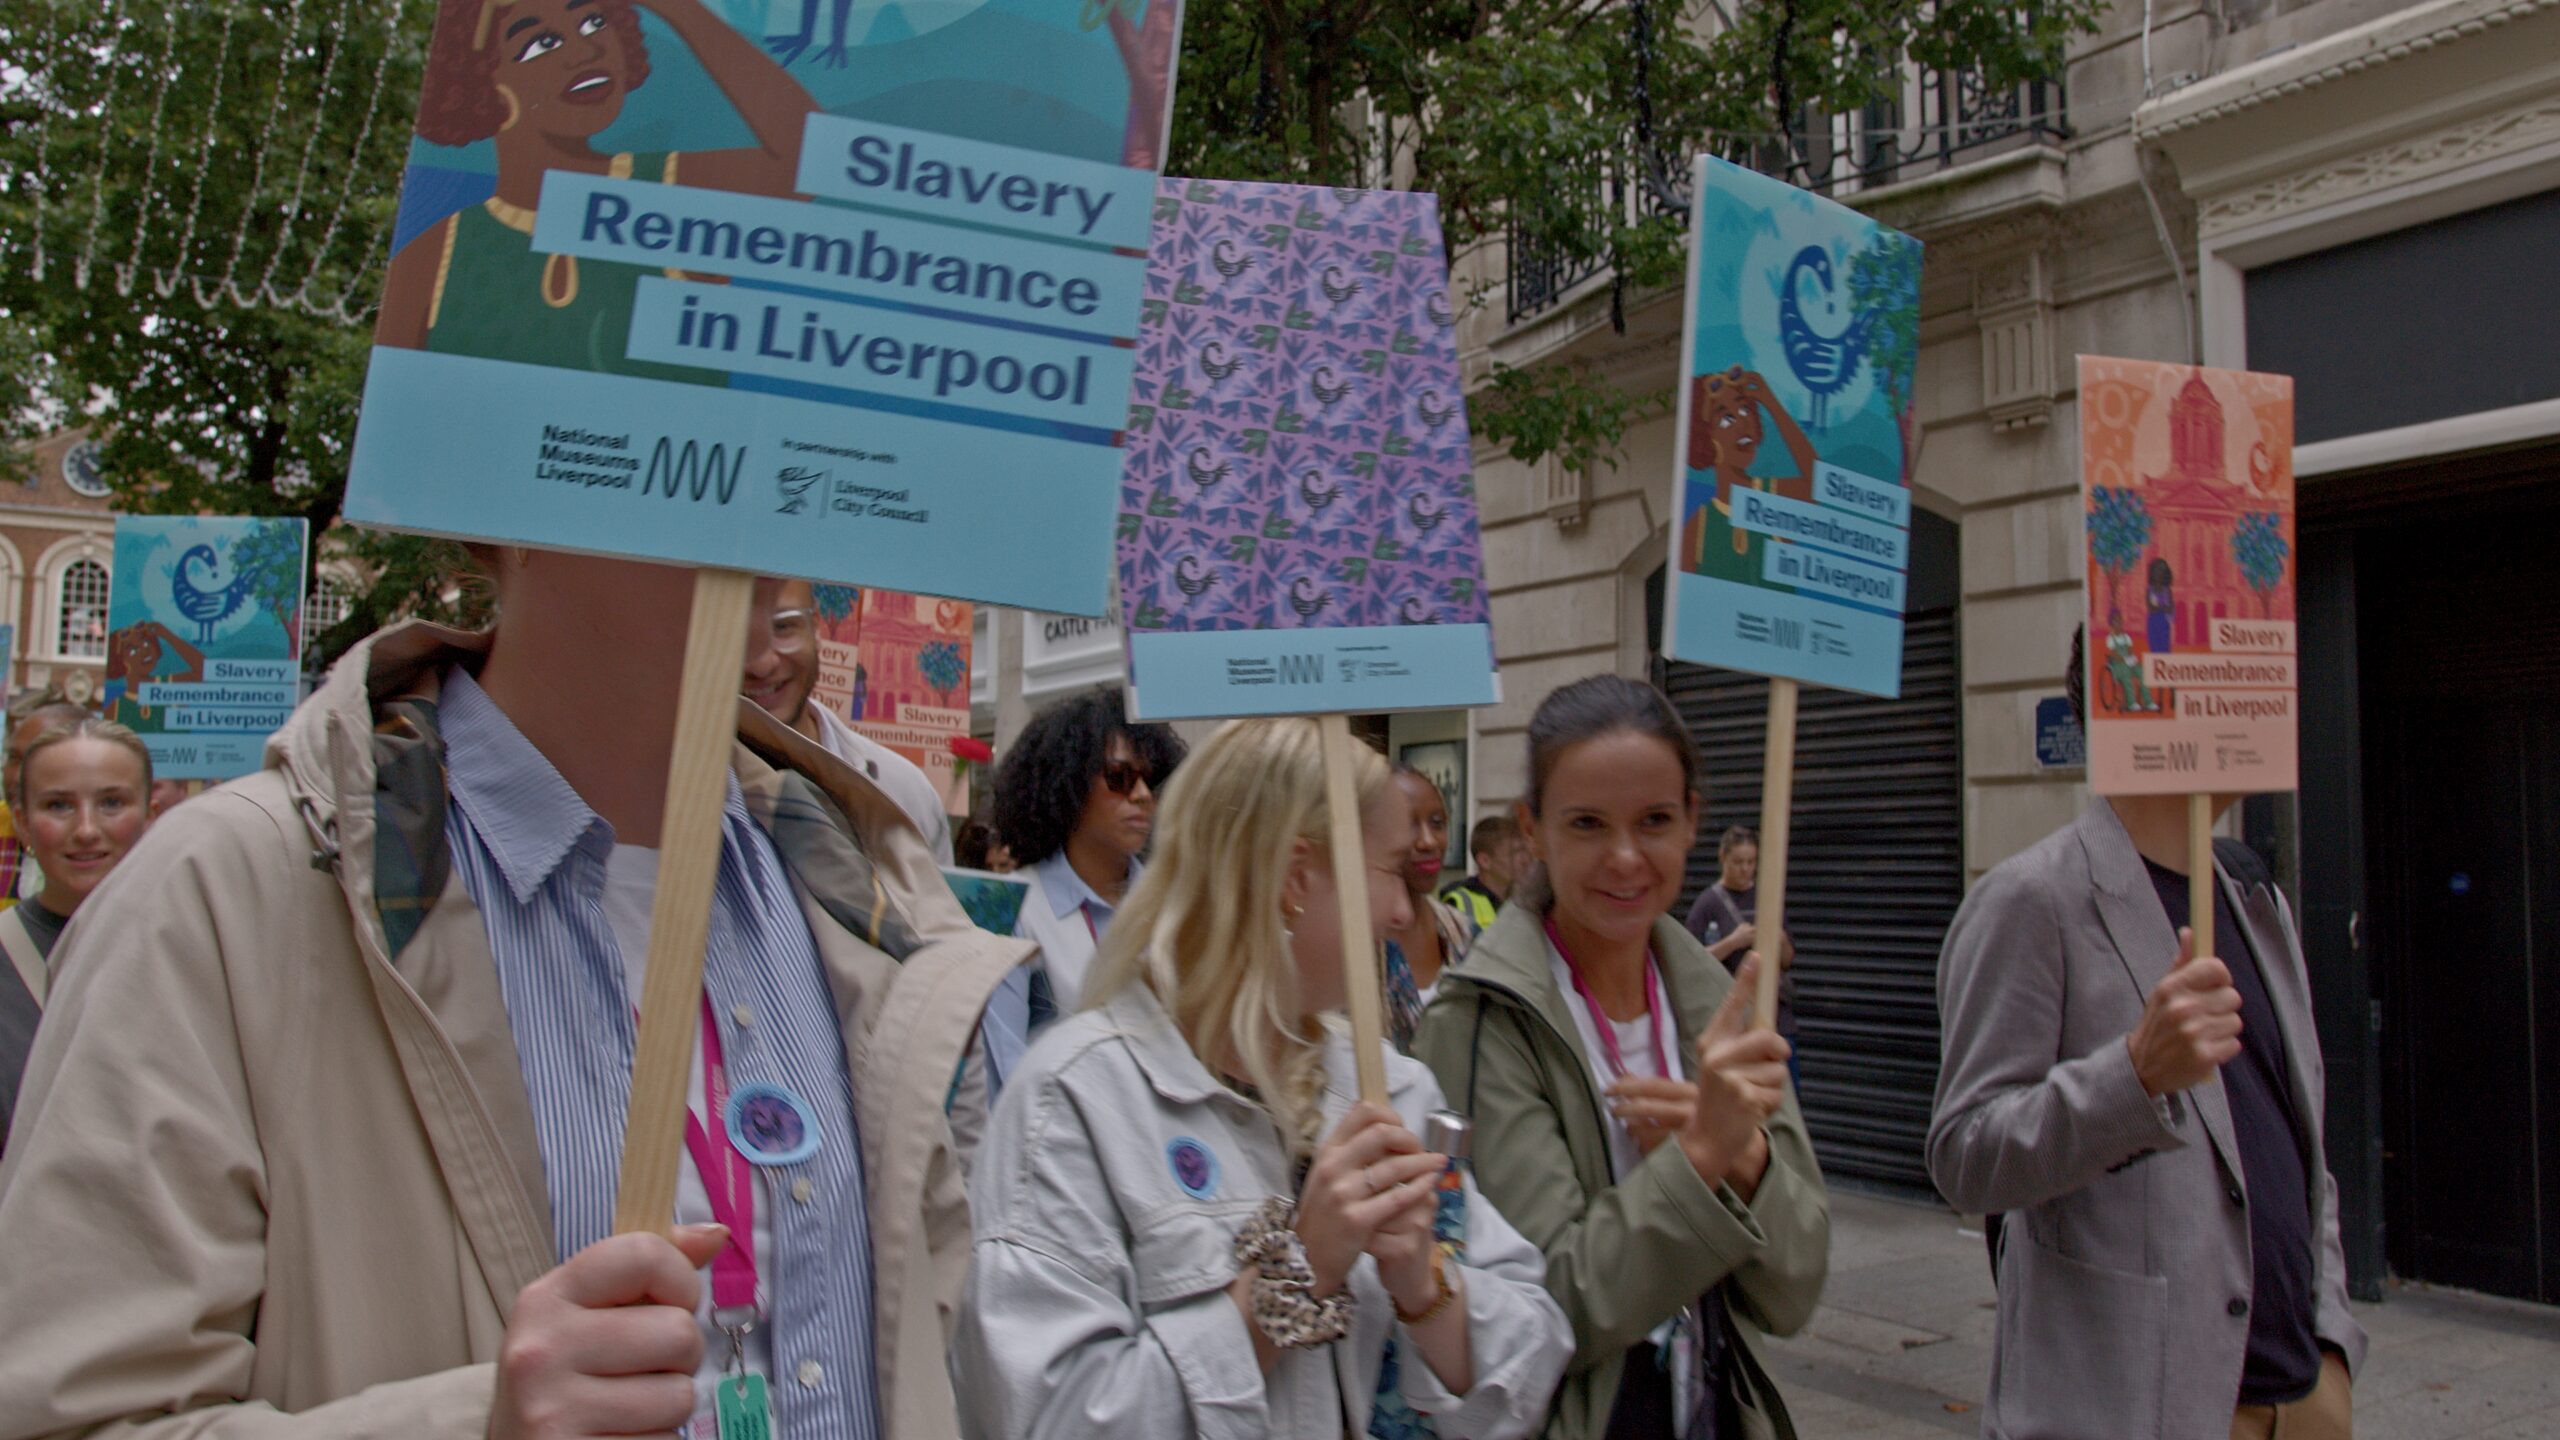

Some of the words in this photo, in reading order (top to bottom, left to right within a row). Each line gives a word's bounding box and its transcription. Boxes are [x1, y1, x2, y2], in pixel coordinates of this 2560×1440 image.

[845, 134, 1115, 235] Slavery
[580, 192, 1101, 316] Remembrance
[676, 295, 738, 351] in
[757, 304, 1090, 406] Liverpool
[543, 424, 630, 450] National
[539, 443, 640, 471] Museums
[536, 462, 633, 489] Liverpool
[834, 479, 910, 503] Liverpool
[1825, 471, 1897, 520] Slavery
[831, 498, 866, 517] City
[867, 503, 930, 523] Council
[1746, 497, 1897, 558] Remembrance
[1778, 550, 1799, 578] in
[1803, 555, 1894, 601] Liverpool
[2219, 623, 2286, 649] Slavery
[215, 662, 287, 680] Slavery
[2153, 658, 2287, 681] Remembrance
[150, 687, 286, 703] Remembrance
[2184, 694, 2202, 716] in
[2206, 694, 2287, 721] Liverpool
[176, 711, 193, 726] in
[197, 711, 285, 729] Liverpool
[904, 707, 962, 728] Slavery
